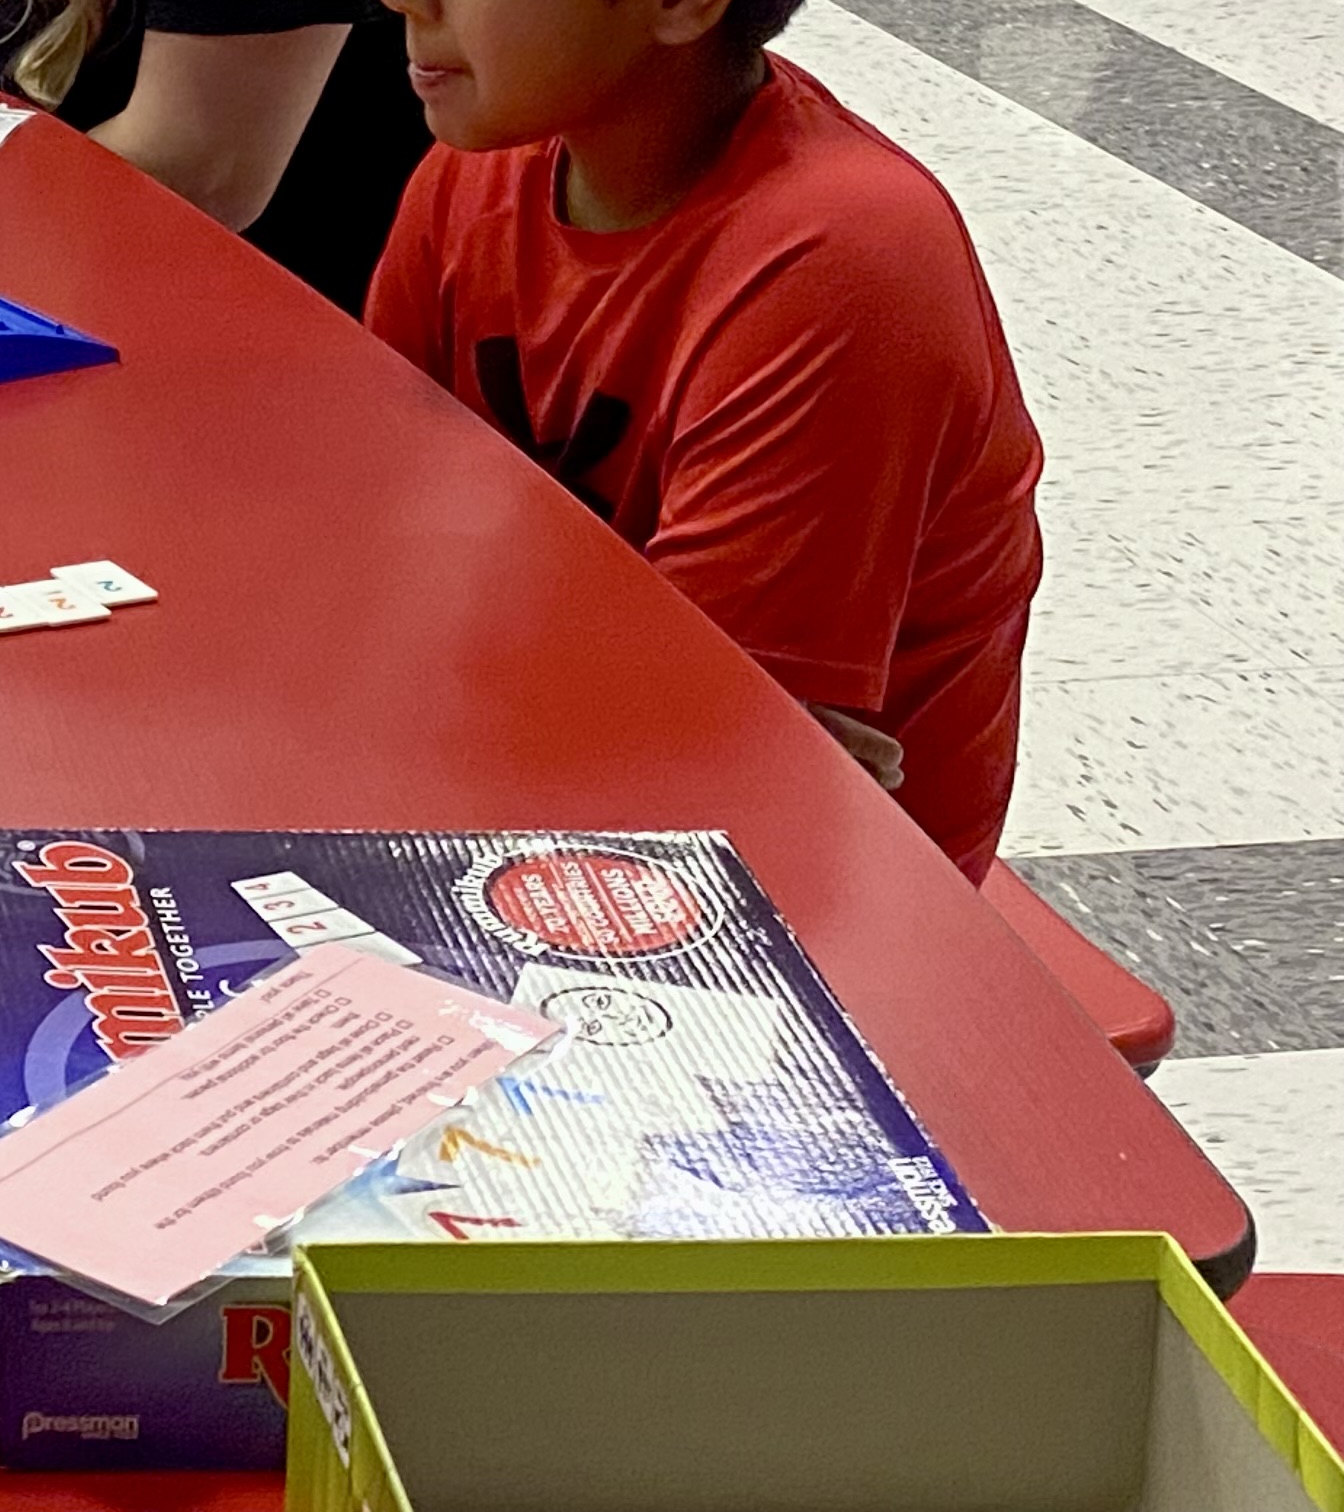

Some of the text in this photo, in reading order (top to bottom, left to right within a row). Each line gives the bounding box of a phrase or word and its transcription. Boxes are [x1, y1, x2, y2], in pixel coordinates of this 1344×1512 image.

[49, 597, 77, 610] 2
[96, 580, 122, 592] 2
[244, 882, 270, 891] 4
[263, 900, 295, 911] 3
[451, 849, 549, 957] Rummikub
[521, 873, 558, 923] YEARS
[601, 868, 658, 935] MILLIONS
[11, 840, 185, 1063] mikub
[286, 921, 328, 934] 2
[150, 887, 216, 1019] PLE TOGETHER
[888, 1158, 956, 1233] essman
